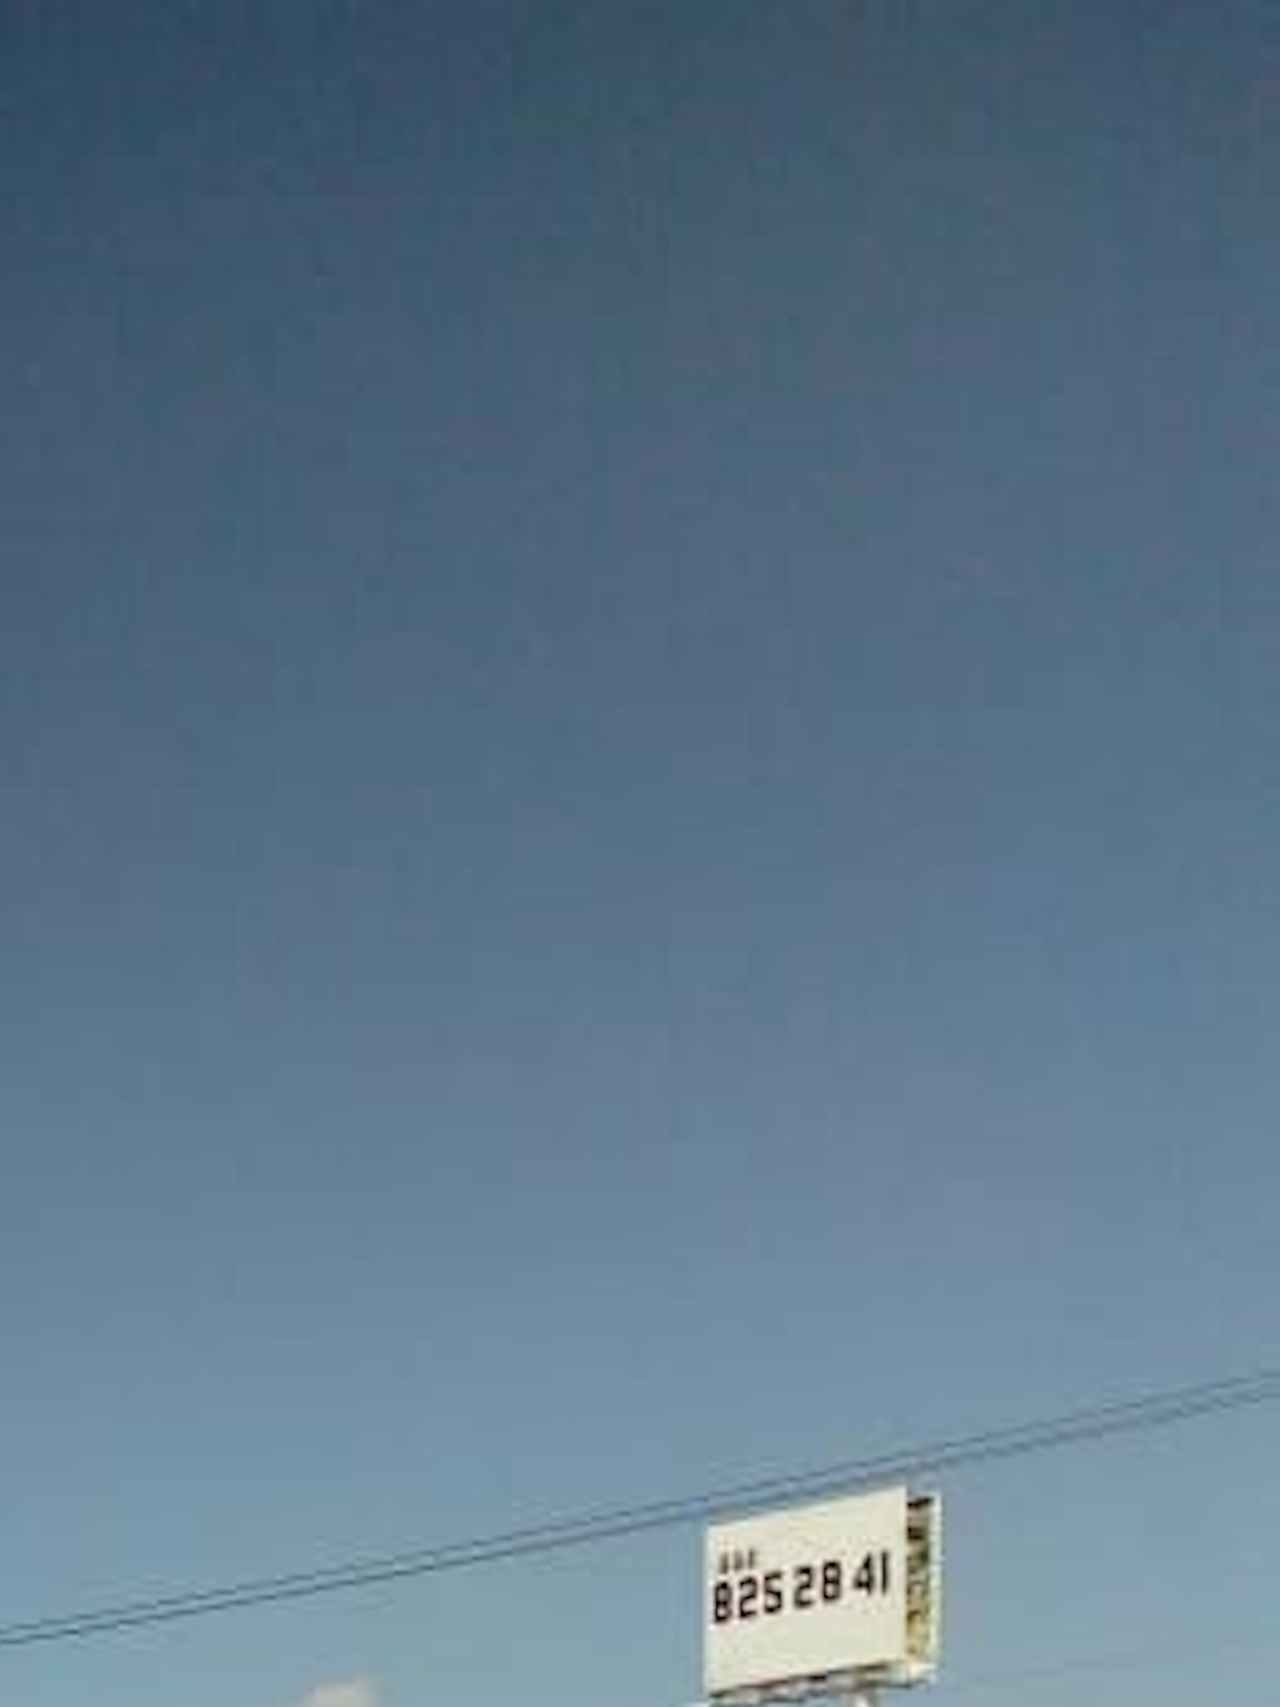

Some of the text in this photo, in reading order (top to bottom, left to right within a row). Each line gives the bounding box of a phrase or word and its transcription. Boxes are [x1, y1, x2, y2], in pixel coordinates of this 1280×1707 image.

[713, 1570, 783, 1624] 825
[794, 1560, 843, 1610] 28
[853, 1551, 889, 1596] 41
